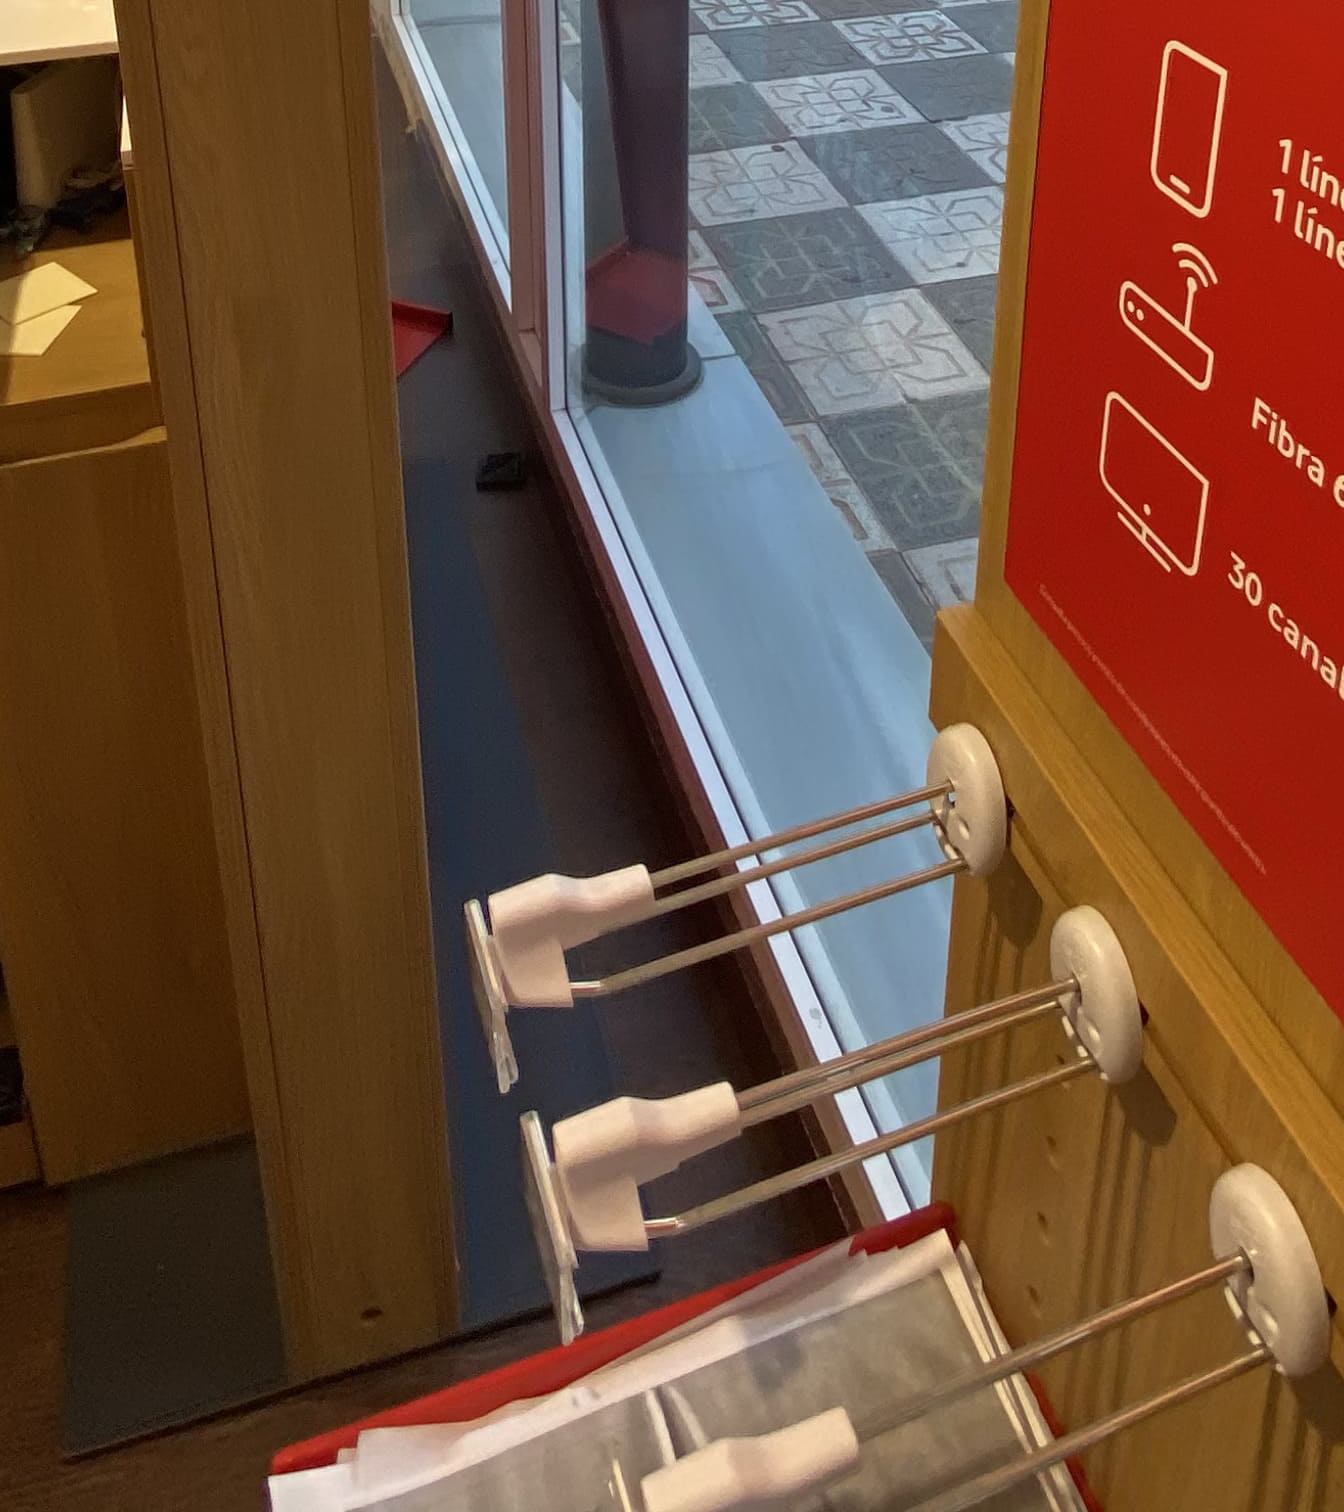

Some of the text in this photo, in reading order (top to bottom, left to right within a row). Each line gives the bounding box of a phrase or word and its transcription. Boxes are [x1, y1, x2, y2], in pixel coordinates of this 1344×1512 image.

[1279, 138, 1293, 174] 1
[1271, 188, 1285, 223] 1
[1251, 397, 1325, 488] Fibra
[1227, 551, 1263, 607] 30
